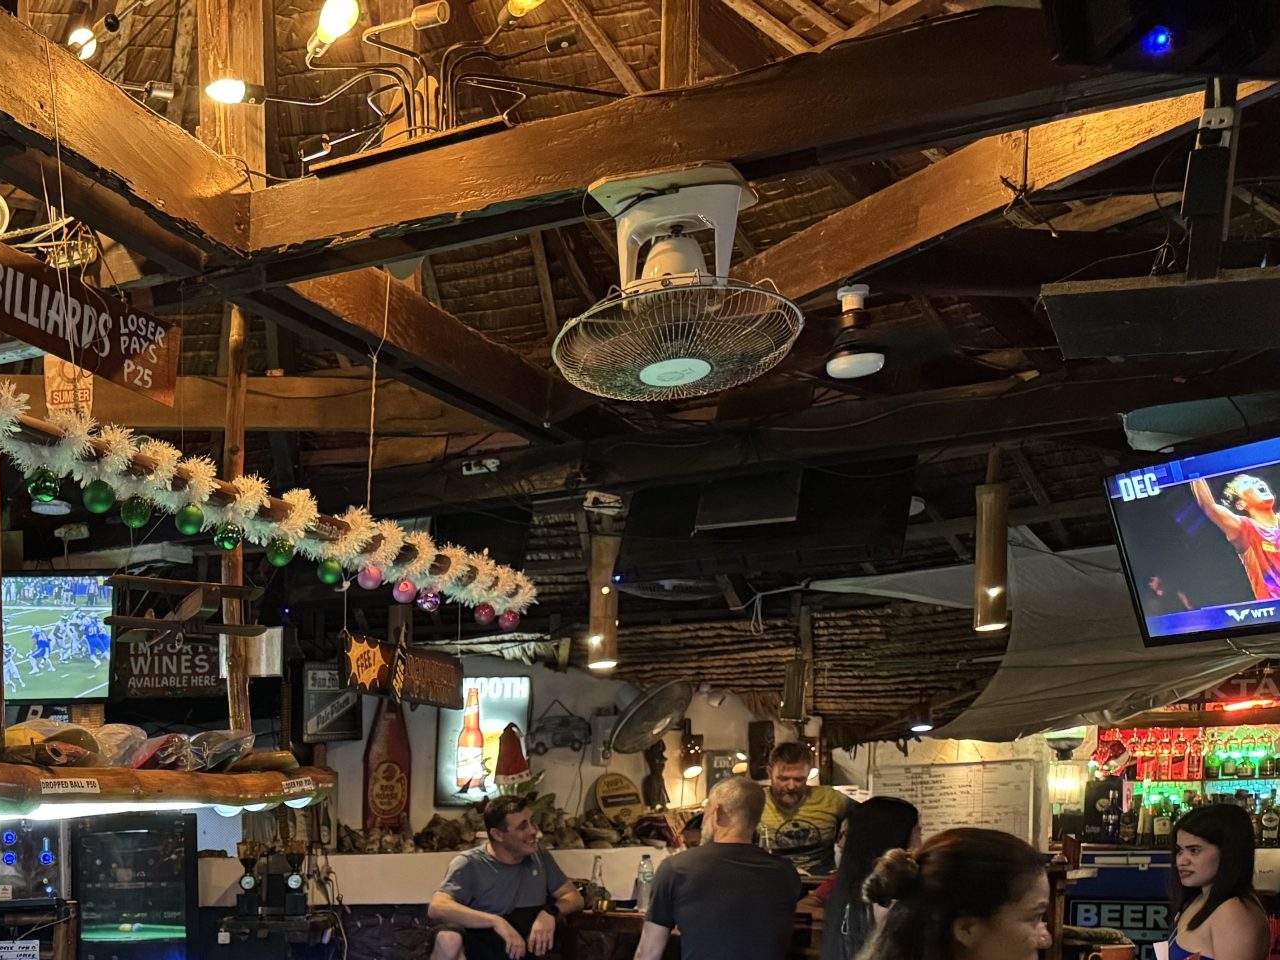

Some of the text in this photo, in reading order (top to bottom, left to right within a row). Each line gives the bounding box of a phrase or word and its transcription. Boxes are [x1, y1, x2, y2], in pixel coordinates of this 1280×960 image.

[120, 313, 166, 348] LOSER
[121, 336, 157, 364] PAYS
[1119, 472, 1161, 502] DEC
[1250, 606, 1276, 619] WTT
[129, 654, 210, 675] WINES
[127, 675, 217, 688] AVAILABLE HERE
[41, 780, 69, 790] DROPPED
[69, 780, 85, 789] BALL
[1076, 903, 1169, 929] BEER
